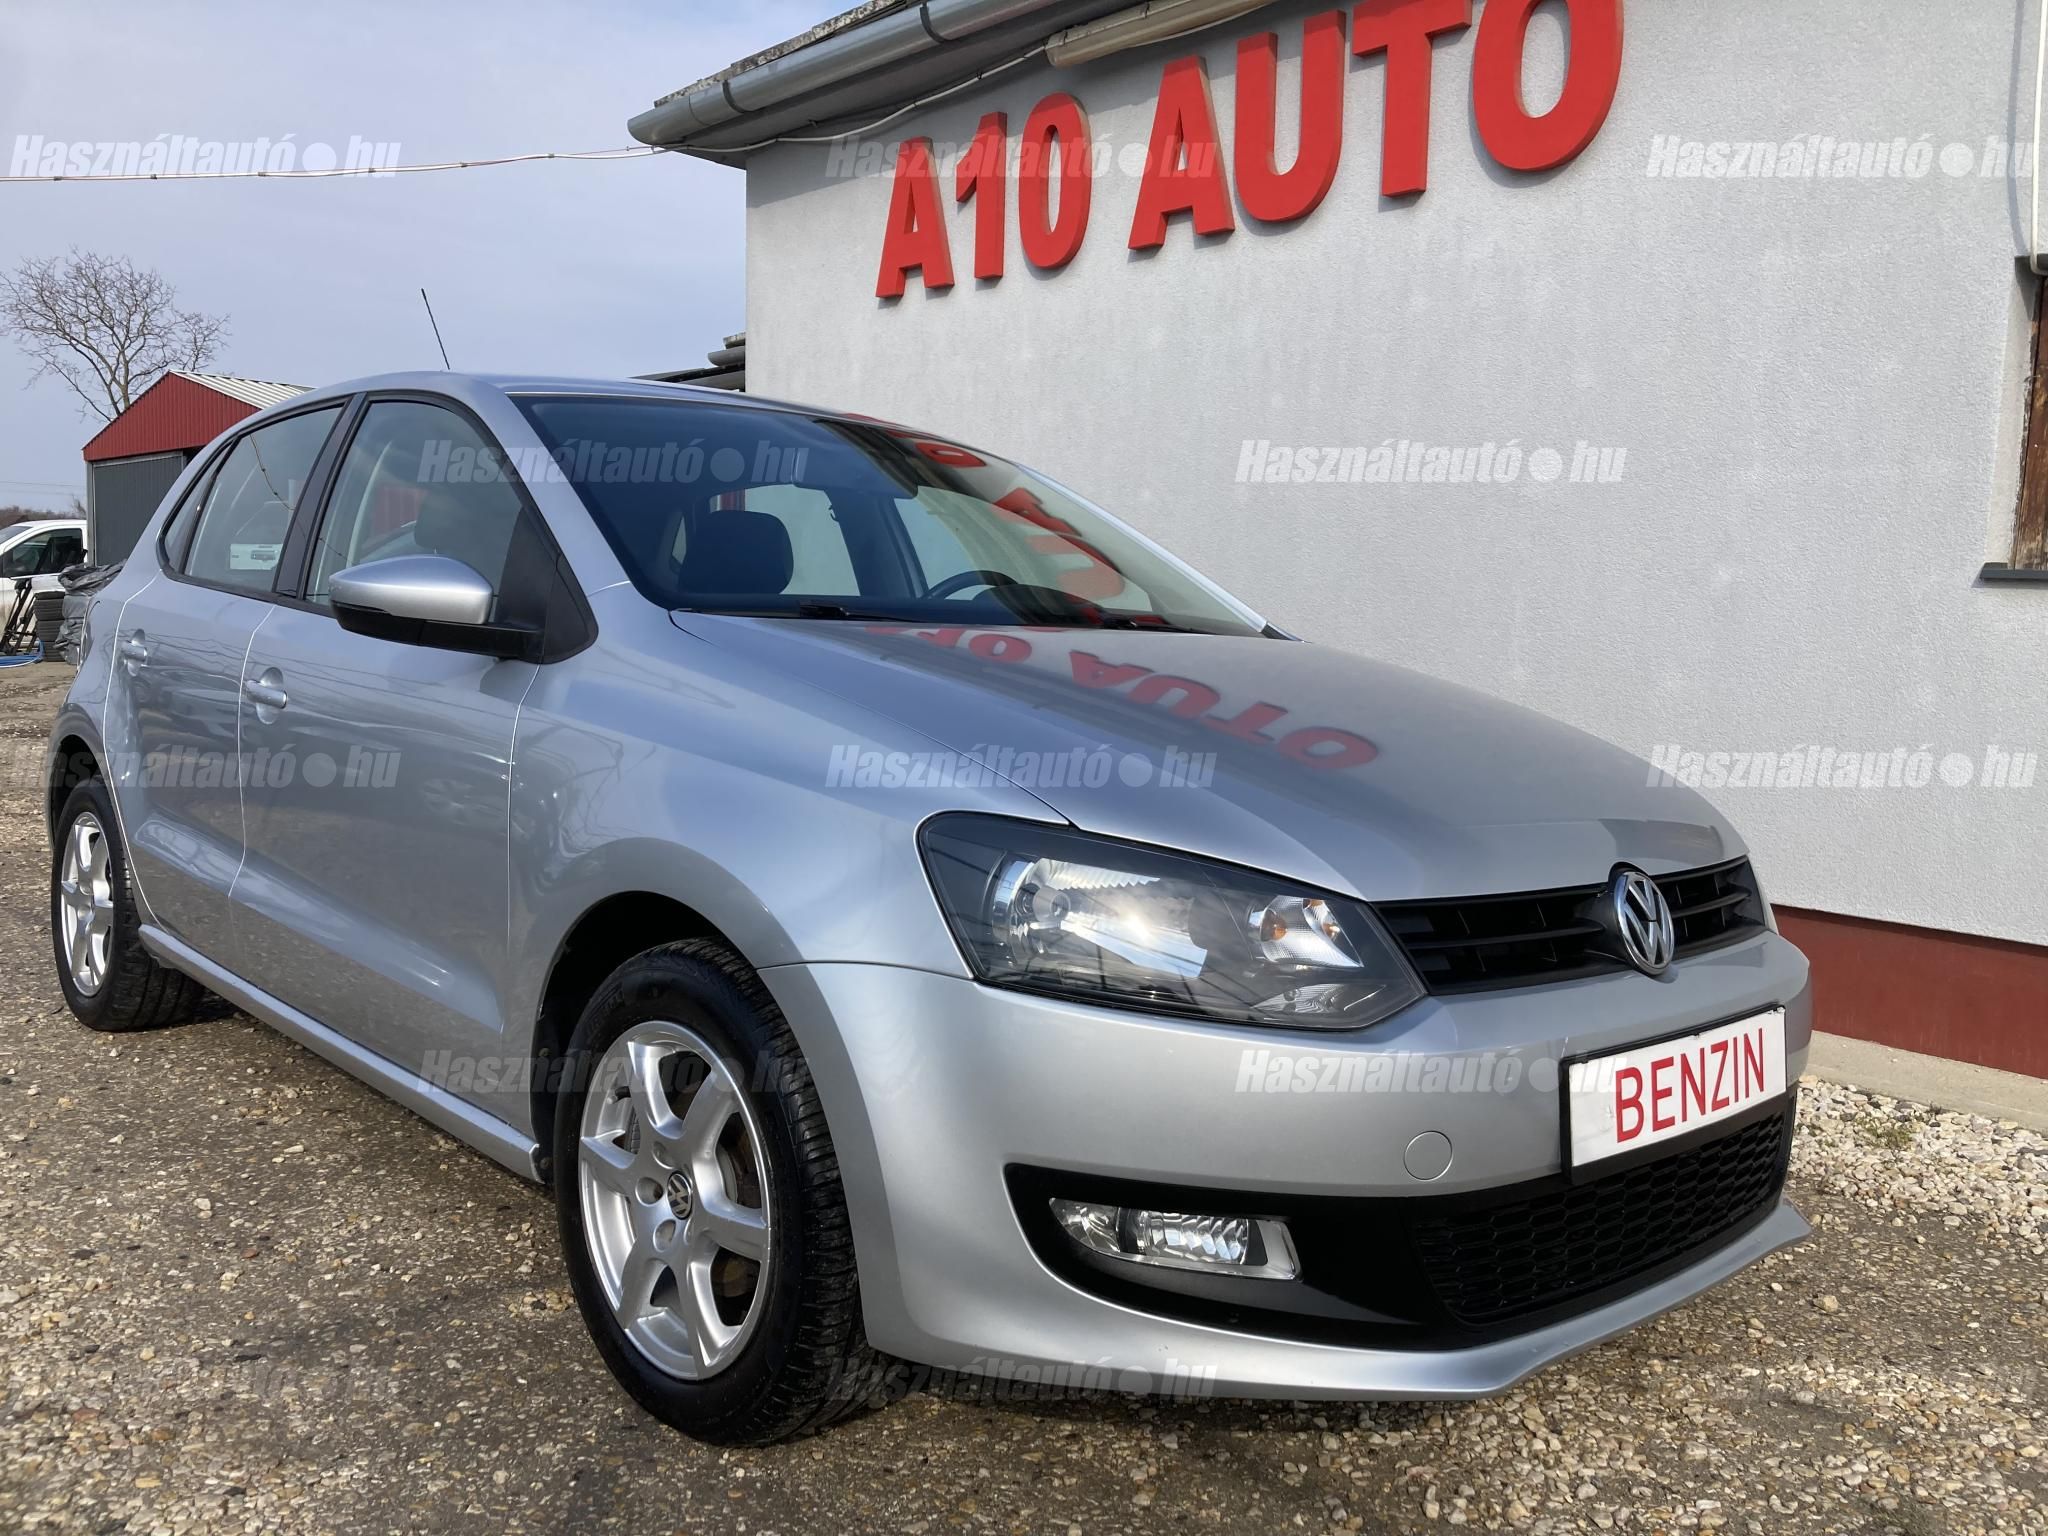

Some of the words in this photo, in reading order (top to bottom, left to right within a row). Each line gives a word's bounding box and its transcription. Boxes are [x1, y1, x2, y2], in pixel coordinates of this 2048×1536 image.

[876, 92, 1092, 299] A10
[1128, 0, 1624, 251] AUTO
[1615, 1028, 1765, 1143] BENZIN
